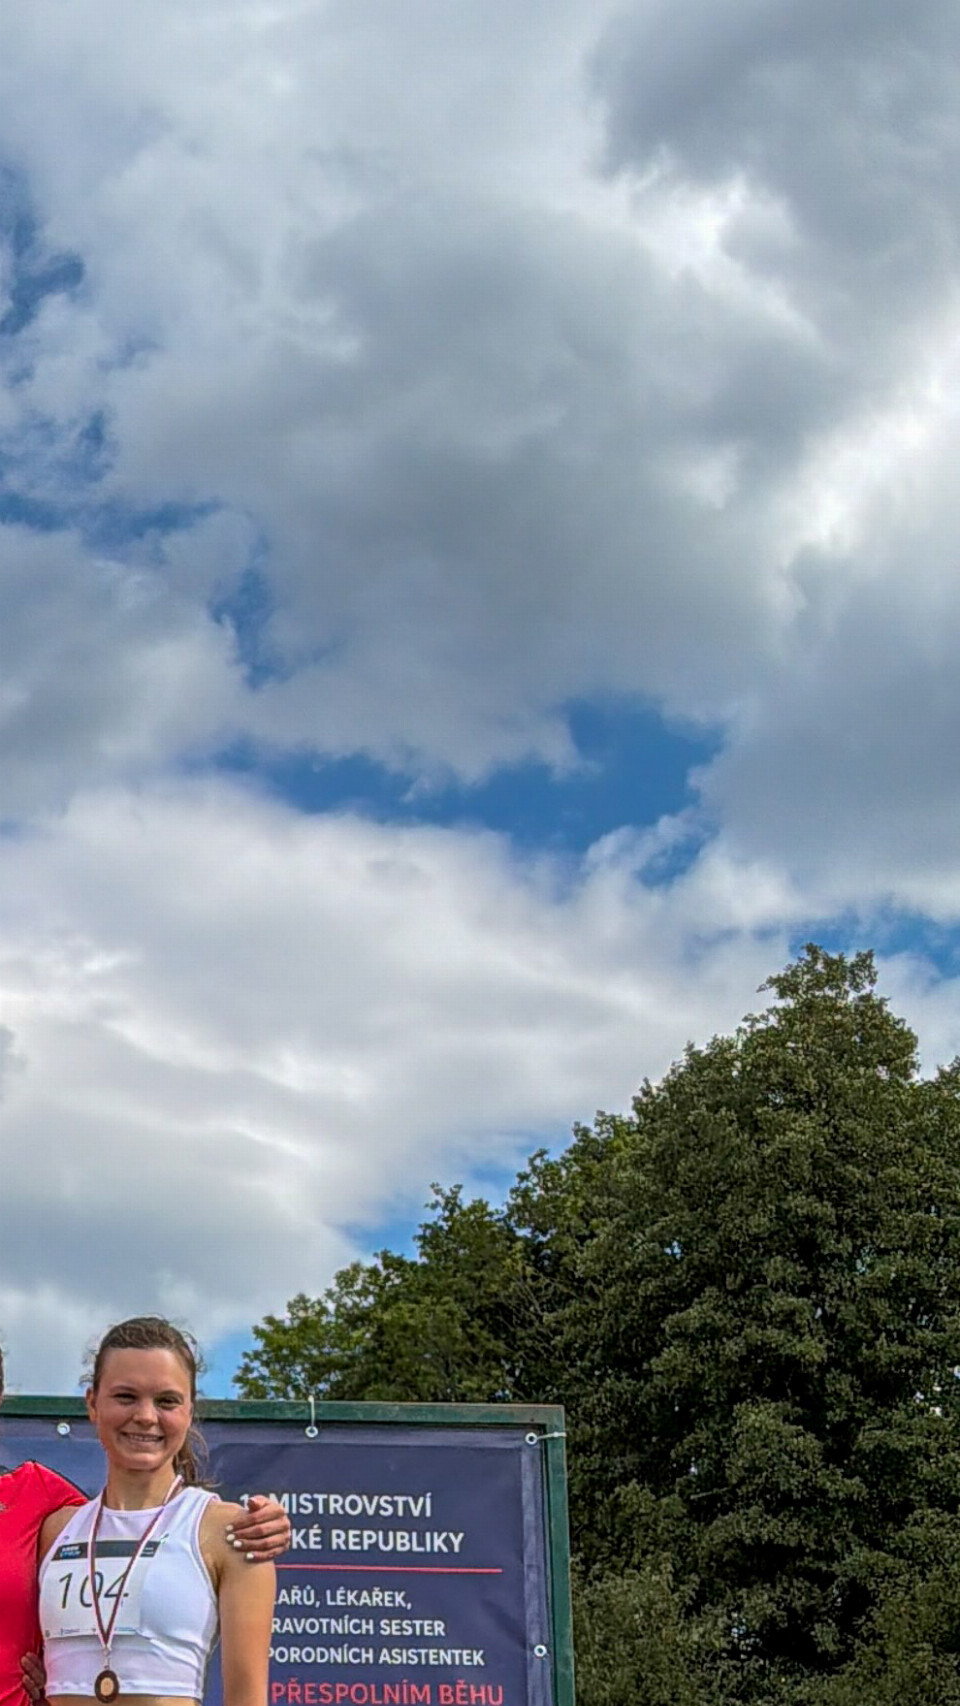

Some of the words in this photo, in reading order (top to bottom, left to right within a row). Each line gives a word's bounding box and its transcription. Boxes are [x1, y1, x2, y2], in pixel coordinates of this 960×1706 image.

[269, 1492, 431, 1517] MISTROVSTVÍ
[331, 1529, 464, 1553] REPUBLIKY
[59, 1571, 129, 1609] 104
[326, 1586, 412, 1610] LÉKAŘEK,
[271, 1614, 374, 1635] RAVOTNÍCH
[380, 1619, 446, 1636] SESTER
[379, 1648, 485, 1666] ASISTENTEK
[271, 1678, 431, 1705] PŘESPOLNÍM
[439, 1679, 503, 1706] BĚHU
